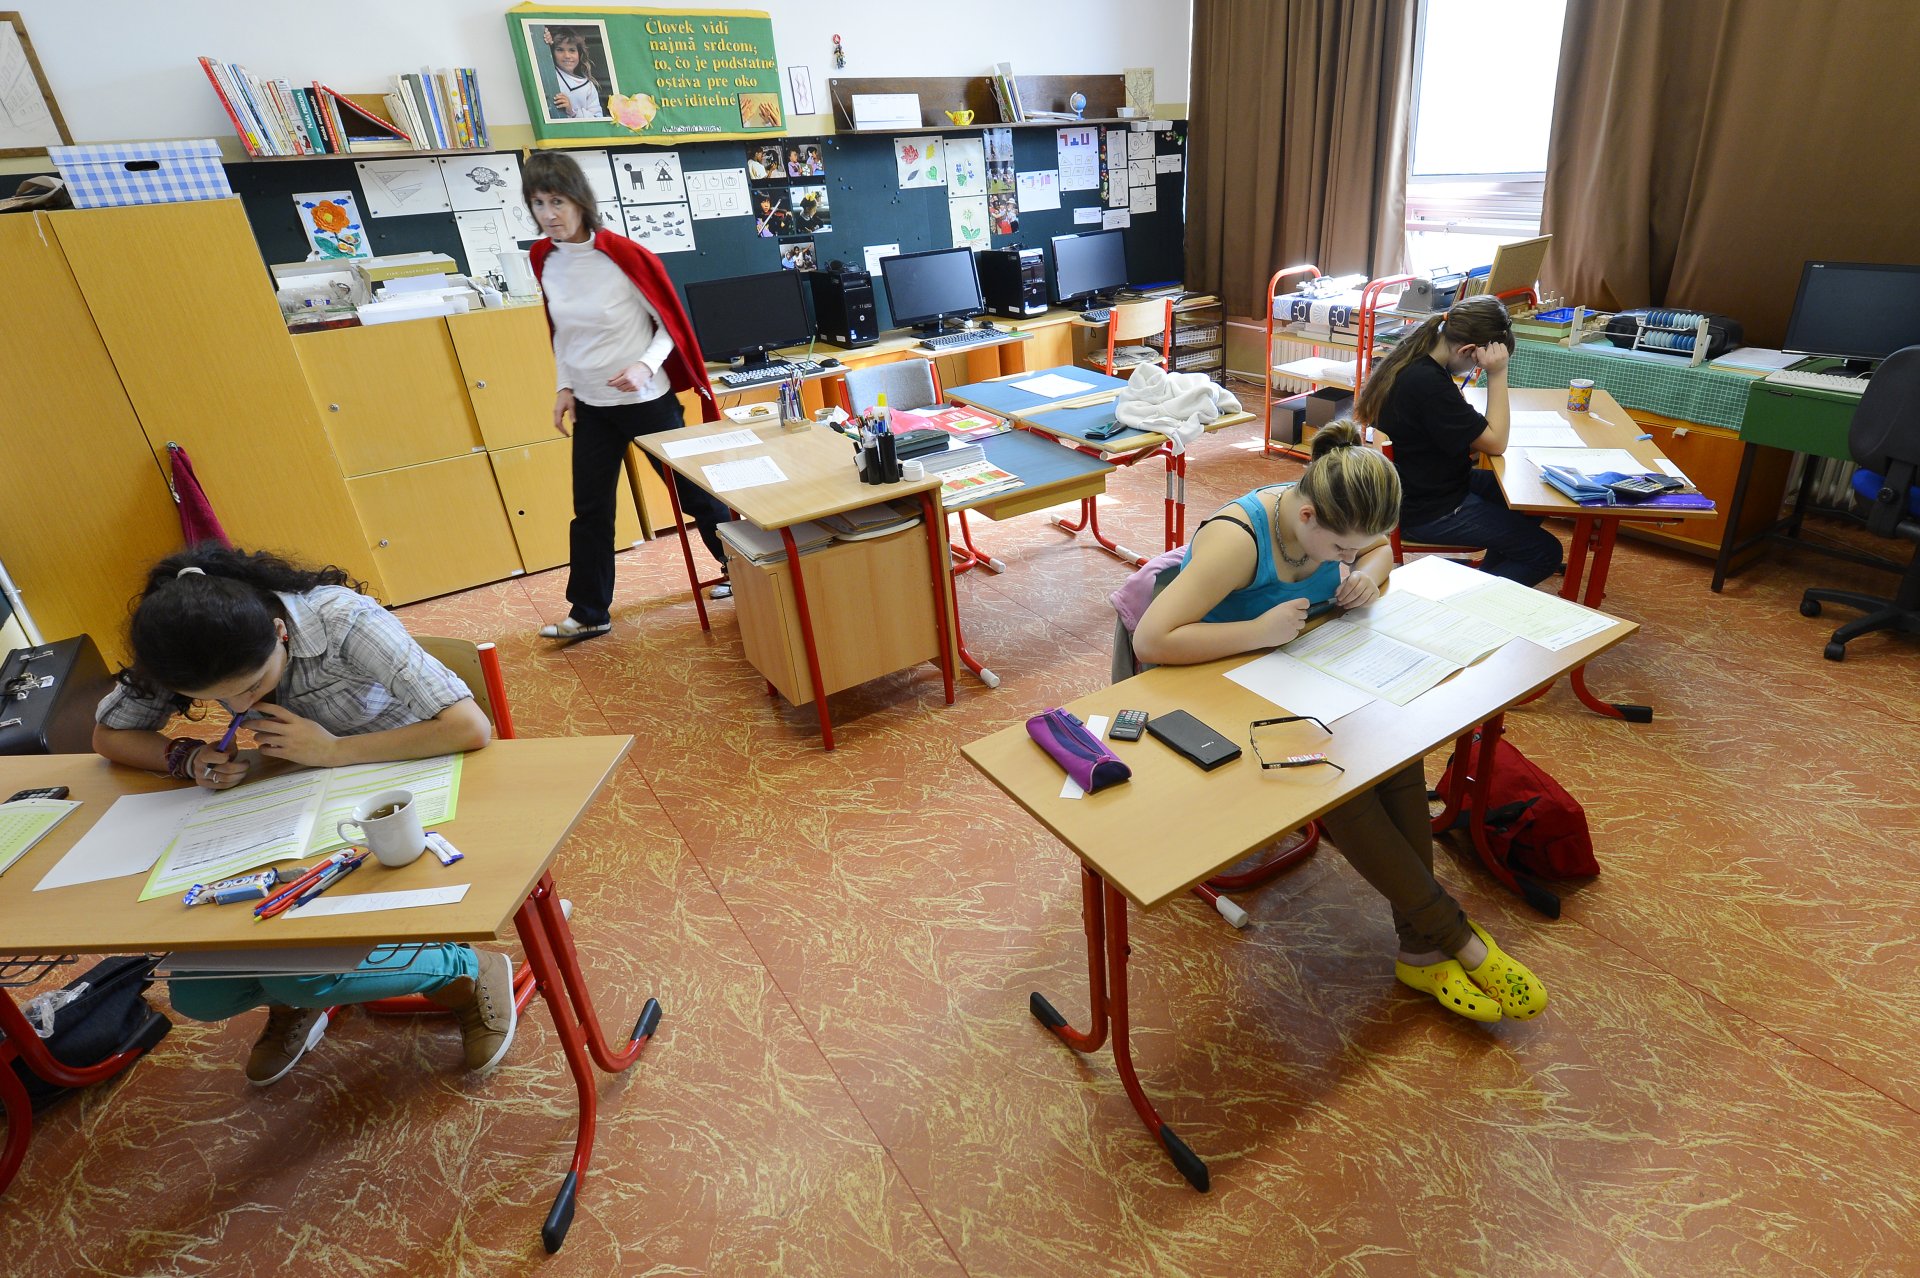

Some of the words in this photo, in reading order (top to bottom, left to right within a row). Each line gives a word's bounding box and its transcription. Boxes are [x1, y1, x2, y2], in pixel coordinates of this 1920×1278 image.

[645, 17, 694, 35] Človek
[702, 20, 729, 35] vidí
[649, 37, 696, 54] najmä
[654, 59, 672, 72] to,
[675, 55, 690, 69] čo
[695, 55, 708, 72] je
[656, 73, 701, 91] ostáva
[707, 76, 729, 90] pre
[734, 74, 758, 87] oko
